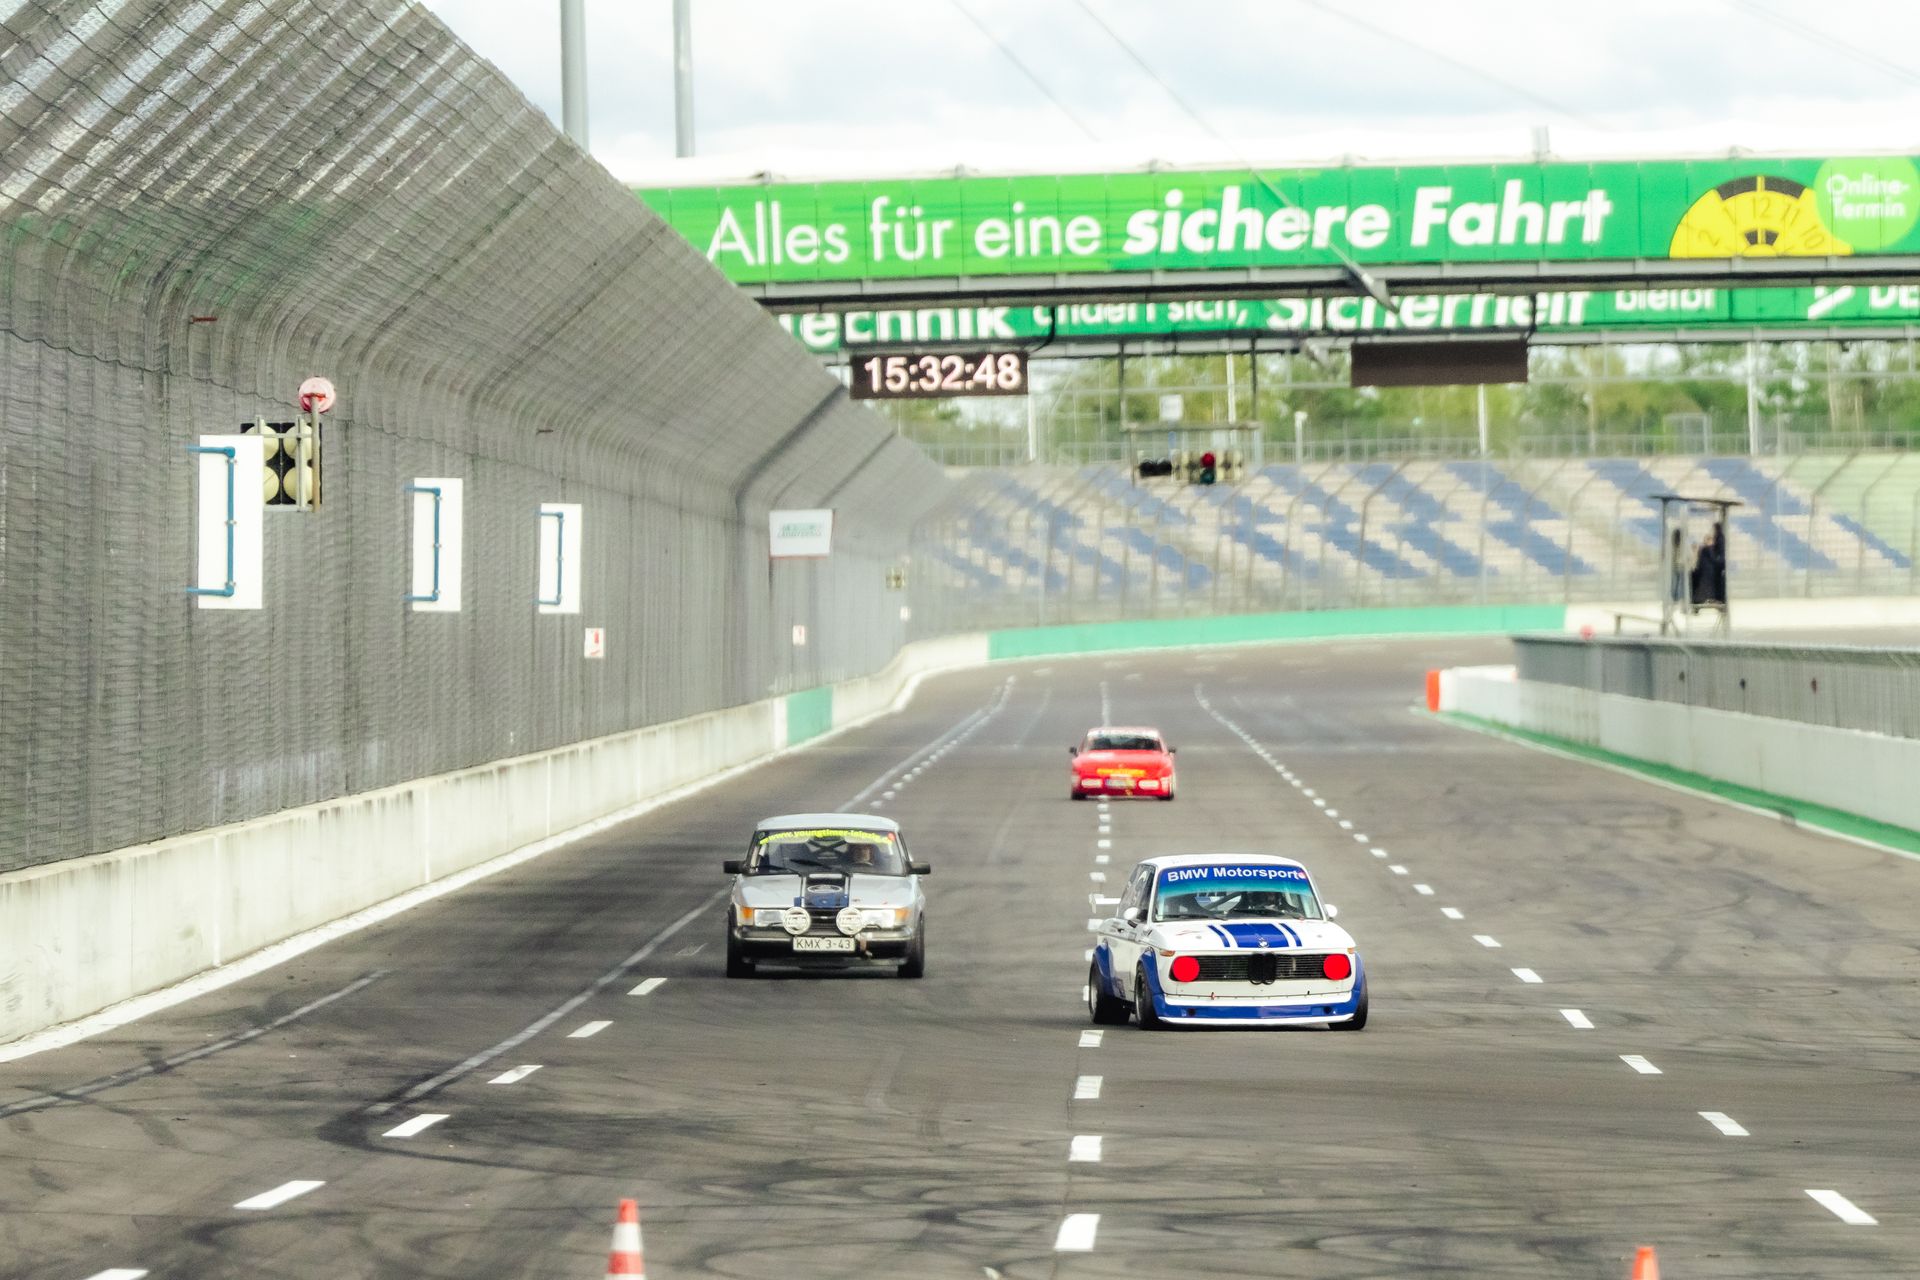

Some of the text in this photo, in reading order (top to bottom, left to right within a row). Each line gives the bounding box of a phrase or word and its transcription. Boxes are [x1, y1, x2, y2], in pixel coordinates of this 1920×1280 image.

[1826, 172, 1910, 196] Online-
[1832, 195, 1906, 218] Termin
[706, 179, 1613, 266] Alles für eine sichere Fahrt
[864, 353, 1022, 393] 15:32:48
[1167, 868, 1209, 882] BMW
[796, 938, 852, 949] KMX 3-43
